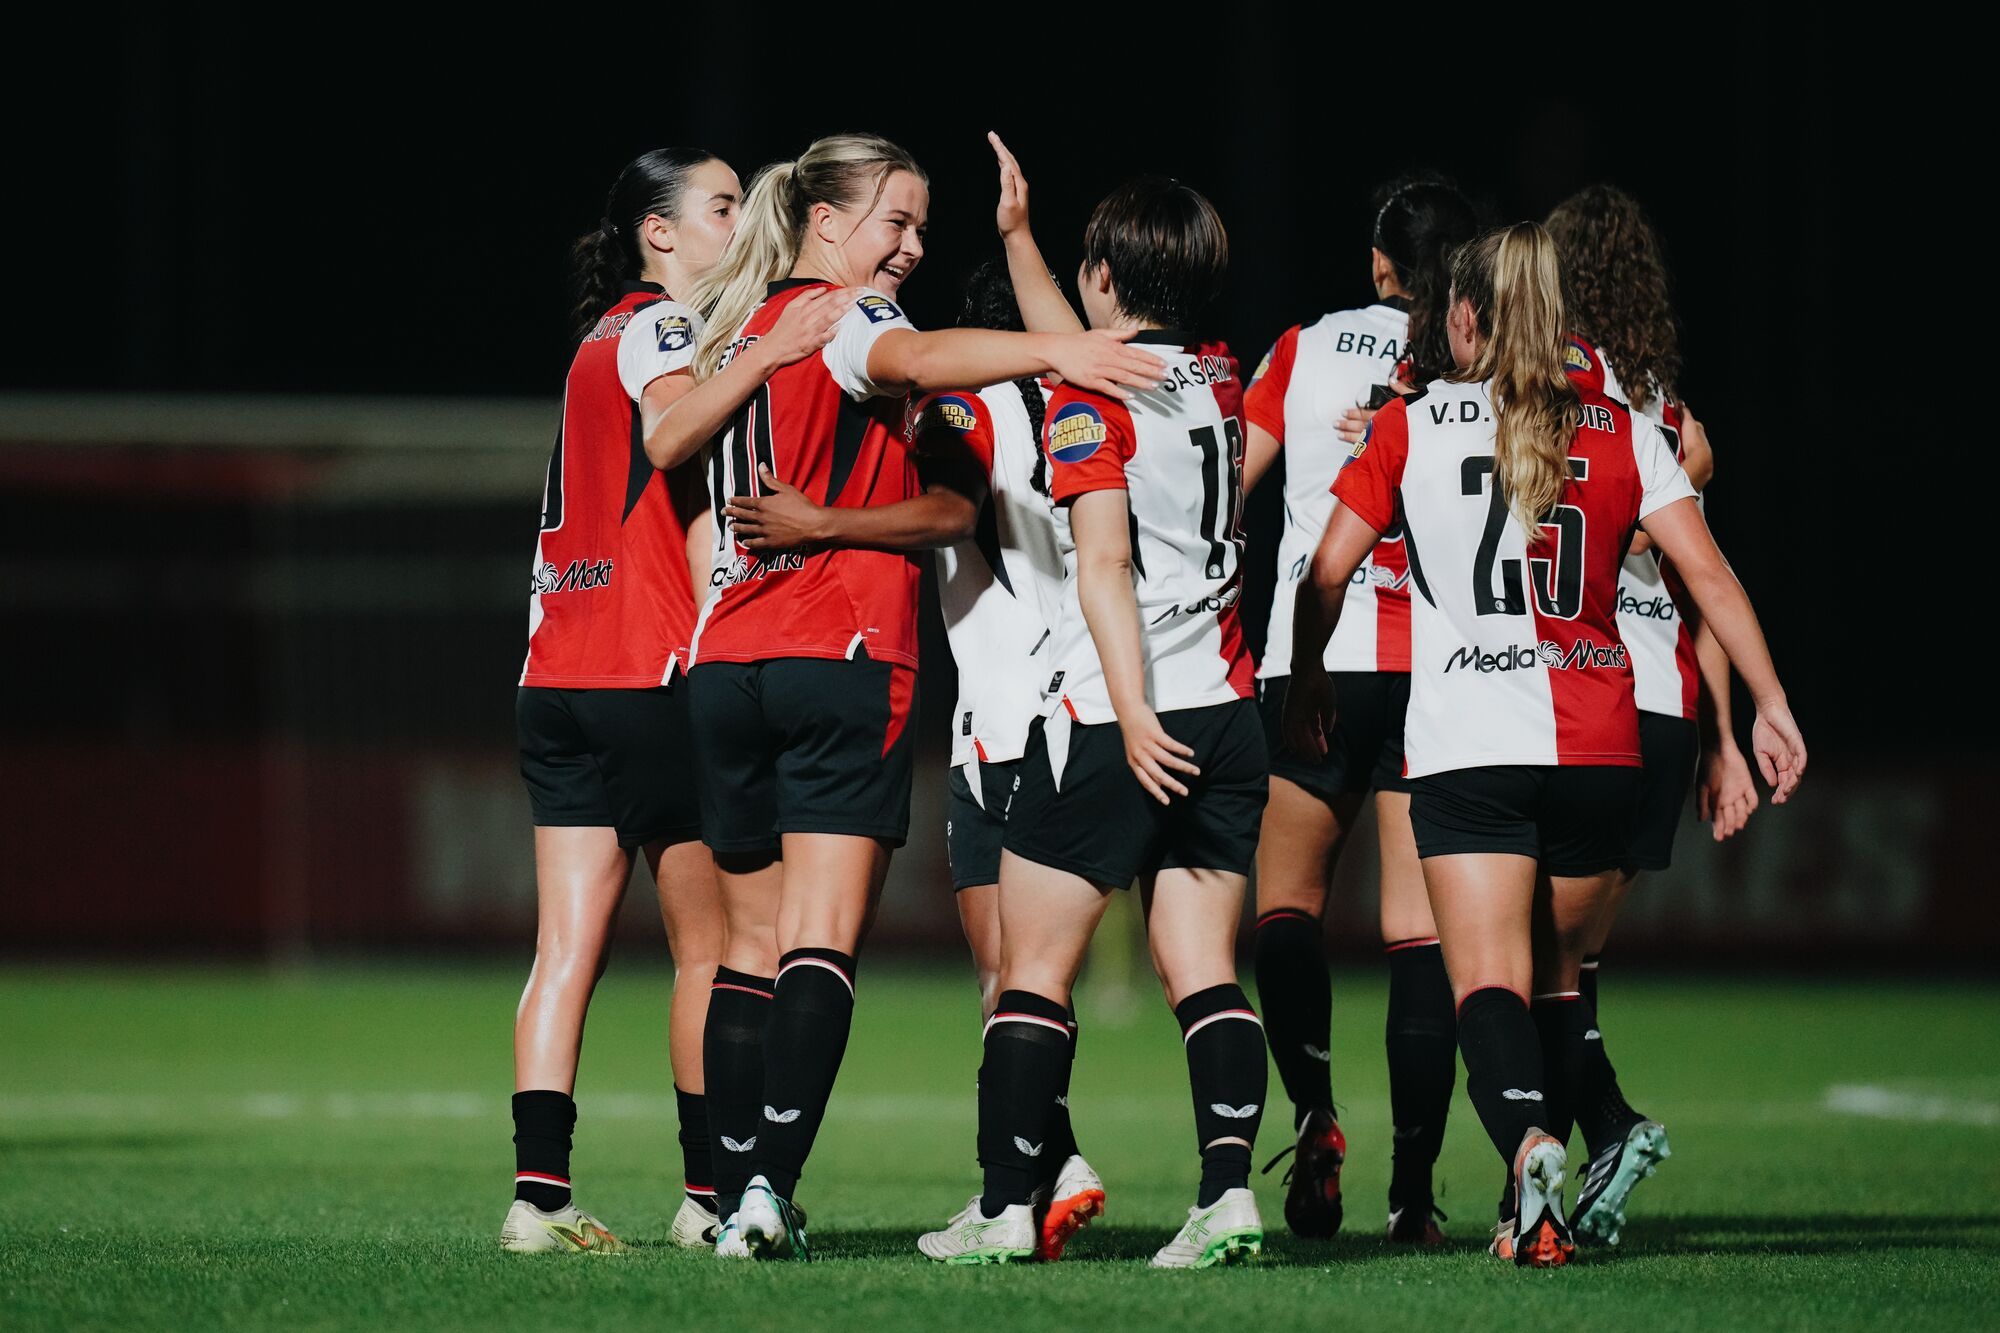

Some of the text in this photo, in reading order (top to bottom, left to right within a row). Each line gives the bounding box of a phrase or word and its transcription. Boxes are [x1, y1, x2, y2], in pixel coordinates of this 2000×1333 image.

[1336, 332, 1398, 361] BRA
[1461, 455, 1589, 622] 25
[1443, 639, 1627, 673] Media Markt
